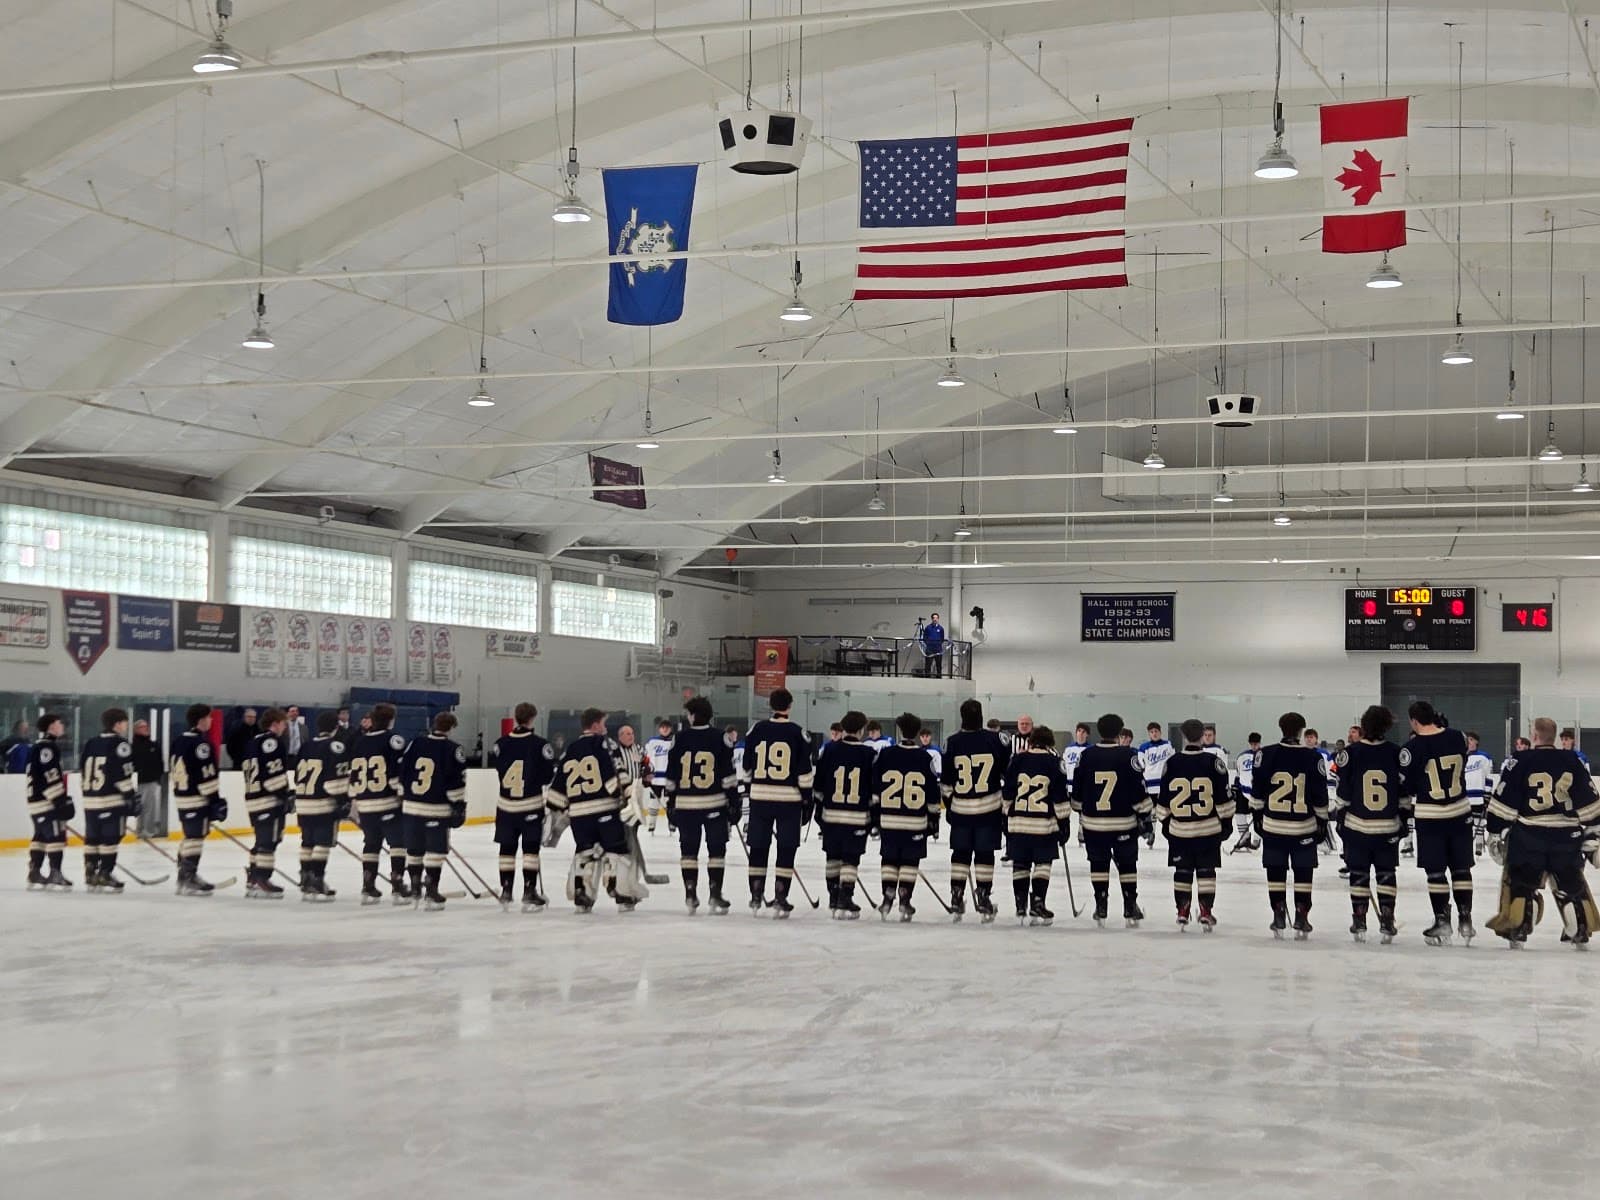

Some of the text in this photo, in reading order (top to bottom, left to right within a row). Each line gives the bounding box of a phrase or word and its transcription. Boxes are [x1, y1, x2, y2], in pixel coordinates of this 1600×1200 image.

[1104, 608, 1151, 617] 1992-93
[1355, 590, 1377, 598] HOME
[1395, 589, 1430, 603] 15:00
[1416, 607, 1422, 617] 1
[1441, 589, 1466, 598] GUEST
[1085, 628, 1171, 637] STATE CHAMPIONS
[1094, 618, 1161, 626] ICE HOCKEY
[83, 756, 107, 791] 15
[266, 758, 283, 774] 22
[296, 759, 323, 795] 27
[350, 755, 387, 797] 33
[411, 757, 435, 795] 3
[503, 759, 525, 798] 4
[563, 755, 602, 797] 29
[680, 751, 715, 789] 13
[754, 740, 791, 780] 19
[954, 753, 994, 794] 37
[1425, 753, 1464, 800] 17
[832, 765, 860, 804] 11
[881, 770, 925, 809] 26
[1015, 772, 1050, 813] 22
[1094, 771, 1118, 811] 7
[1169, 777, 1214, 817] 23
[1268, 771, 1308, 814] 21
[1362, 769, 1388, 811] 6
[1528, 771, 1573, 812] 34
